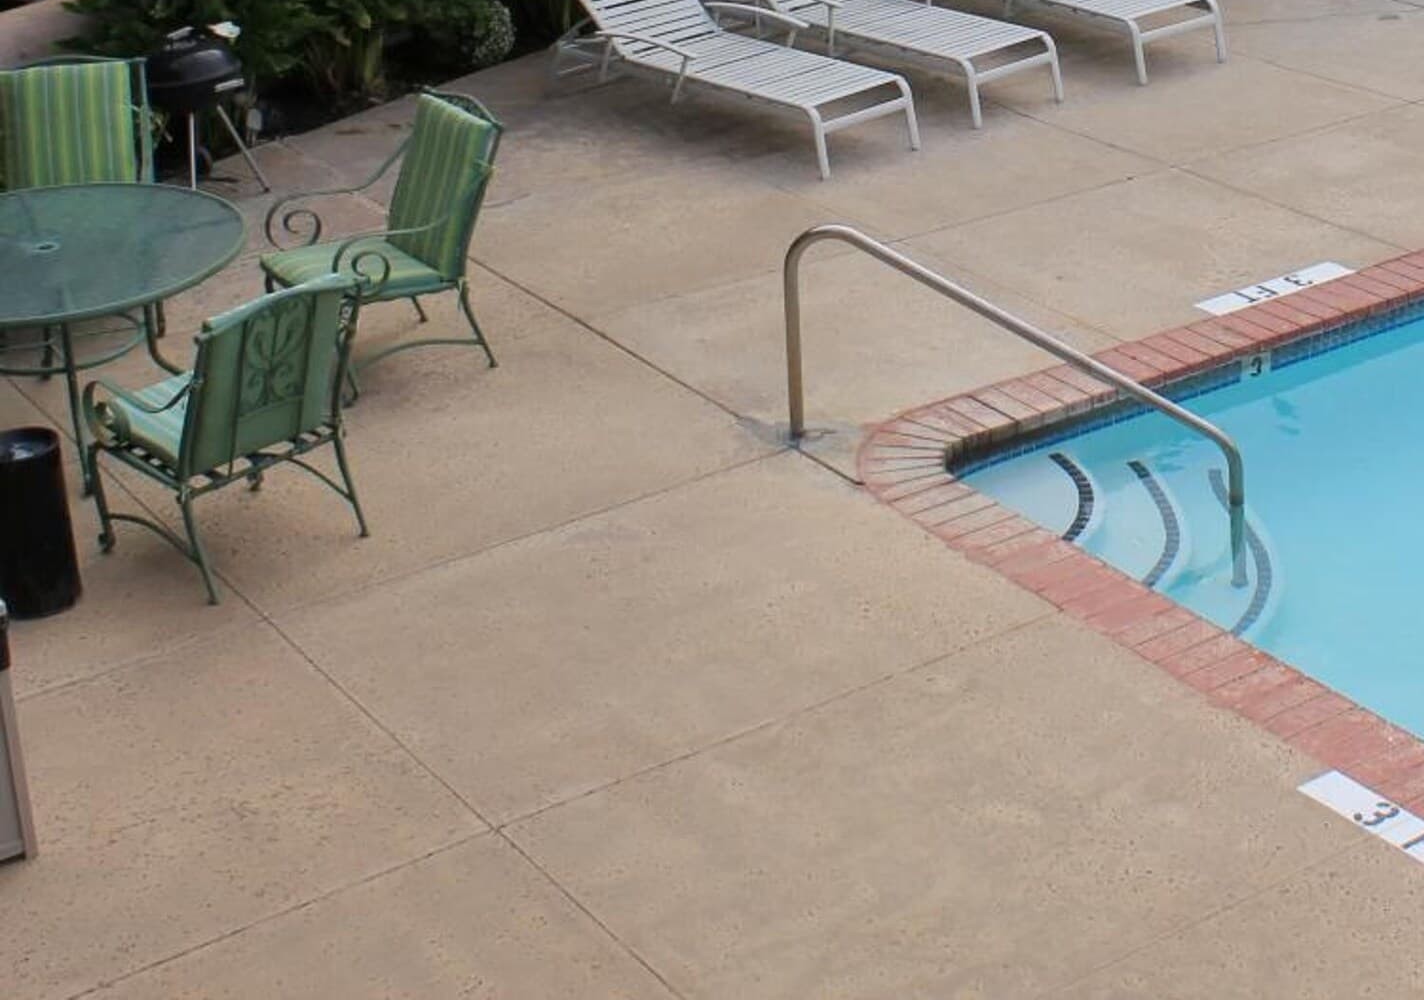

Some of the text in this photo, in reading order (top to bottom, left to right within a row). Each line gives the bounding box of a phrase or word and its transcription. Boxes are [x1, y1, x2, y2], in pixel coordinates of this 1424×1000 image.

[1233, 275, 1314, 303] 3 FT
[1353, 802, 1400, 826] 3
